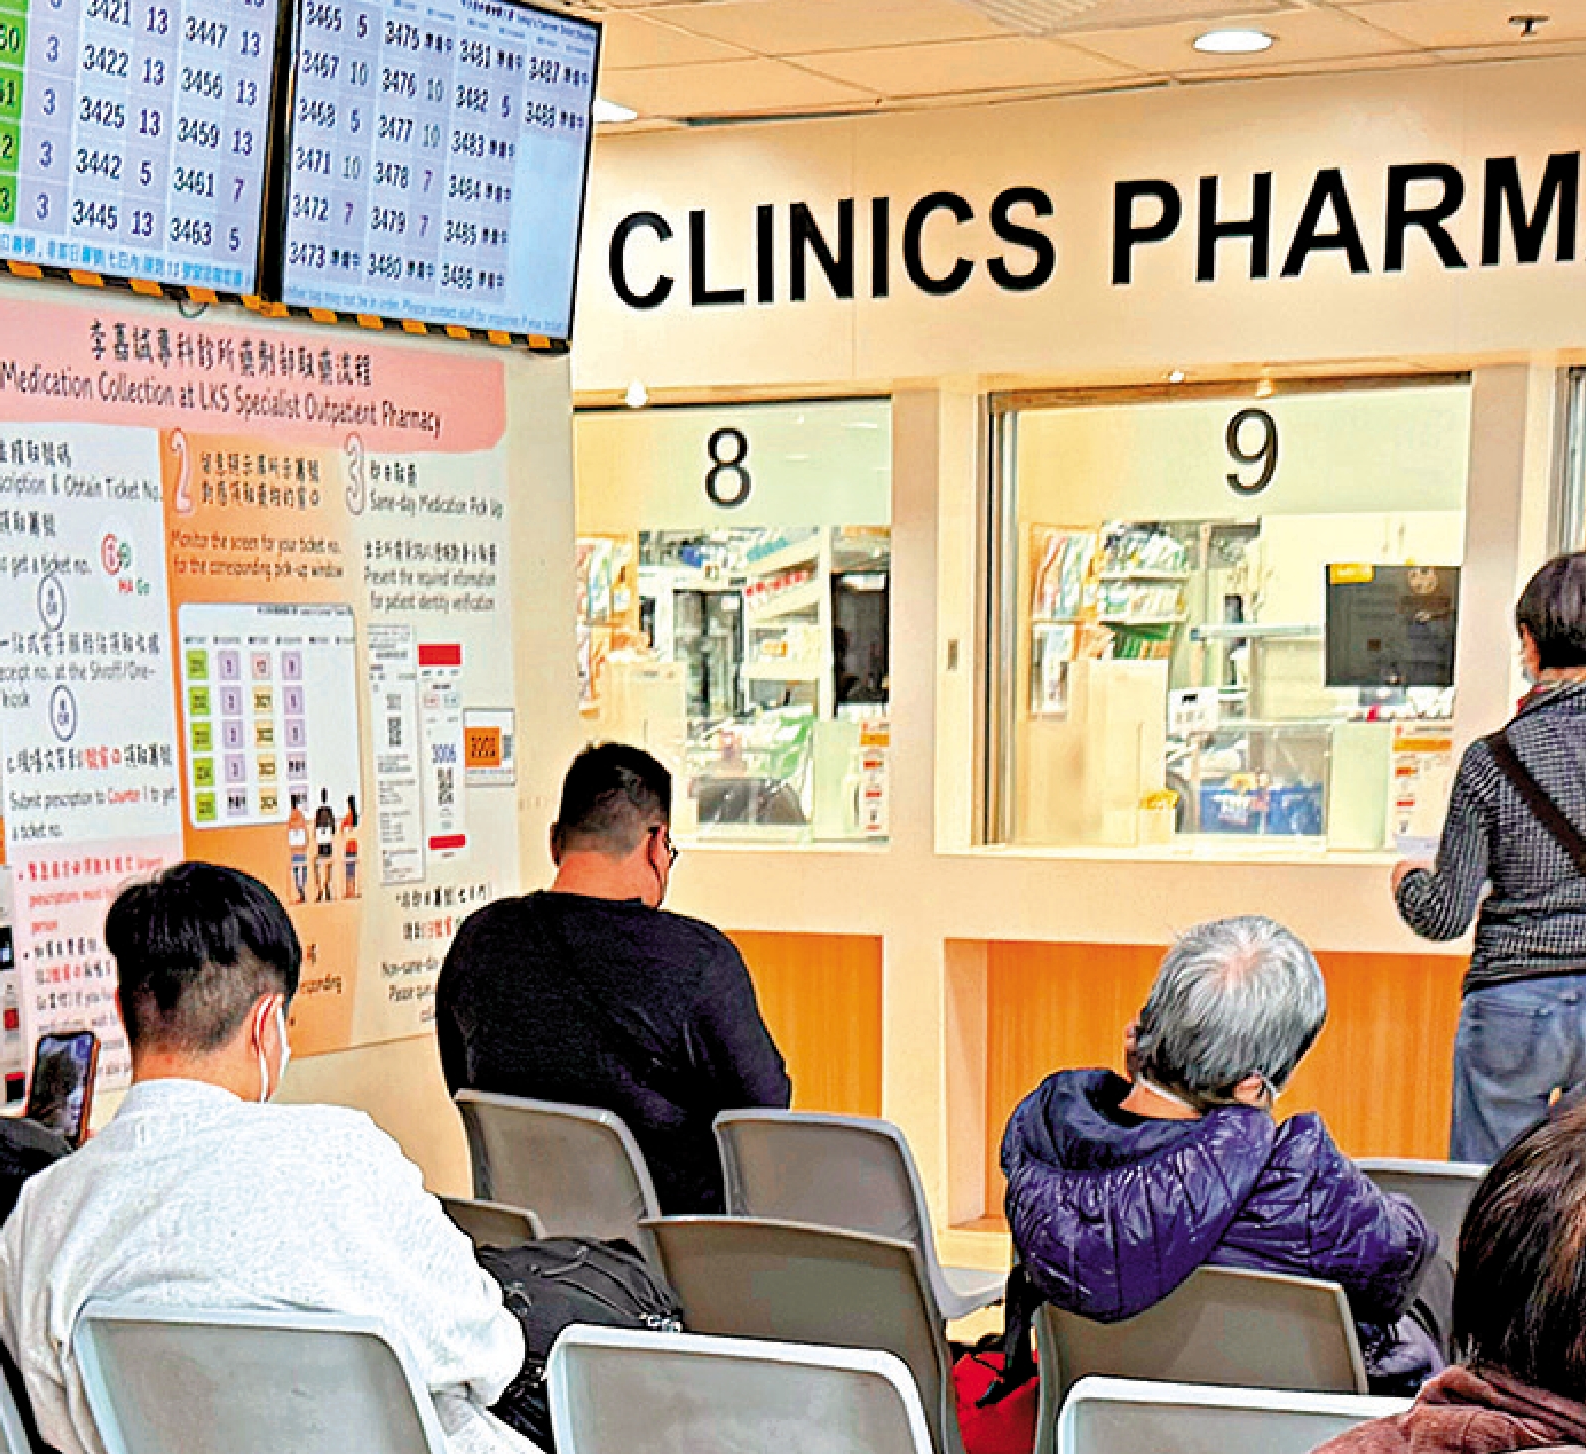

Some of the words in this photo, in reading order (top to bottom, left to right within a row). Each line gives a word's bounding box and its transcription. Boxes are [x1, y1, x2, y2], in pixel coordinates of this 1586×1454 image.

[47, 36, 59, 62] 3
[147, 6, 167, 34] 13
[185, 15, 227, 48] 3447
[241, 30, 260, 57] 13
[357, 14, 368, 38] 5
[385, 20, 420, 51] 3475
[43, 88, 56, 115] 3
[83, 43, 128, 78] 3422
[143, 57, 165, 85] 13
[181, 67, 223, 99] 3456
[237, 80, 257, 107] 13
[350, 61, 369, 87] 10
[427, 78, 443, 102] 10
[502, 95, 511, 118] 5
[40, 140, 52, 167] 3
[79, 95, 125, 130] 3425
[139, 109, 160, 137] 13
[178, 117, 220, 150] 3459
[233, 129, 252, 156] 13
[350, 109, 361, 133] 5
[379, 114, 413, 144] 3477
[423, 124, 440, 149] 10
[37, 193, 49, 220] 3
[76, 148, 122, 181] 3442
[141, 161, 152, 186] 5
[174, 166, 214, 198] 3461
[233, 179, 244, 203] 7
[296, 146, 331, 175] 3471
[343, 155, 361, 180] 10
[424, 170, 433, 192] 7
[72, 199, 118, 231] 3445
[132, 211, 154, 237] 13
[170, 218, 212, 247] 3463
[229, 227, 240, 252] 5
[292, 193, 329, 222] 3472
[345, 202, 353, 225] 7
[419, 215, 429, 237] 7
[289, 241, 326, 269] 3473
[610, 189, 1055, 308] CLINICS
[0, 361, 93, 399] Medication
[98, 371, 174, 407] Collection
[179, 385, 195, 409] at
[198, 382, 230, 413] LKS
[235, 385, 300, 421] Specialist
[305, 392, 377, 428] Outpatient
[382, 399, 441, 438] Pharmacy
[170, 427, 193, 516] 2
[706, 427, 751, 507] 8
[1225, 408, 1280, 494] 9
[64, 475, 102, 496] Obtain
[105, 477, 139, 499] Ticket
